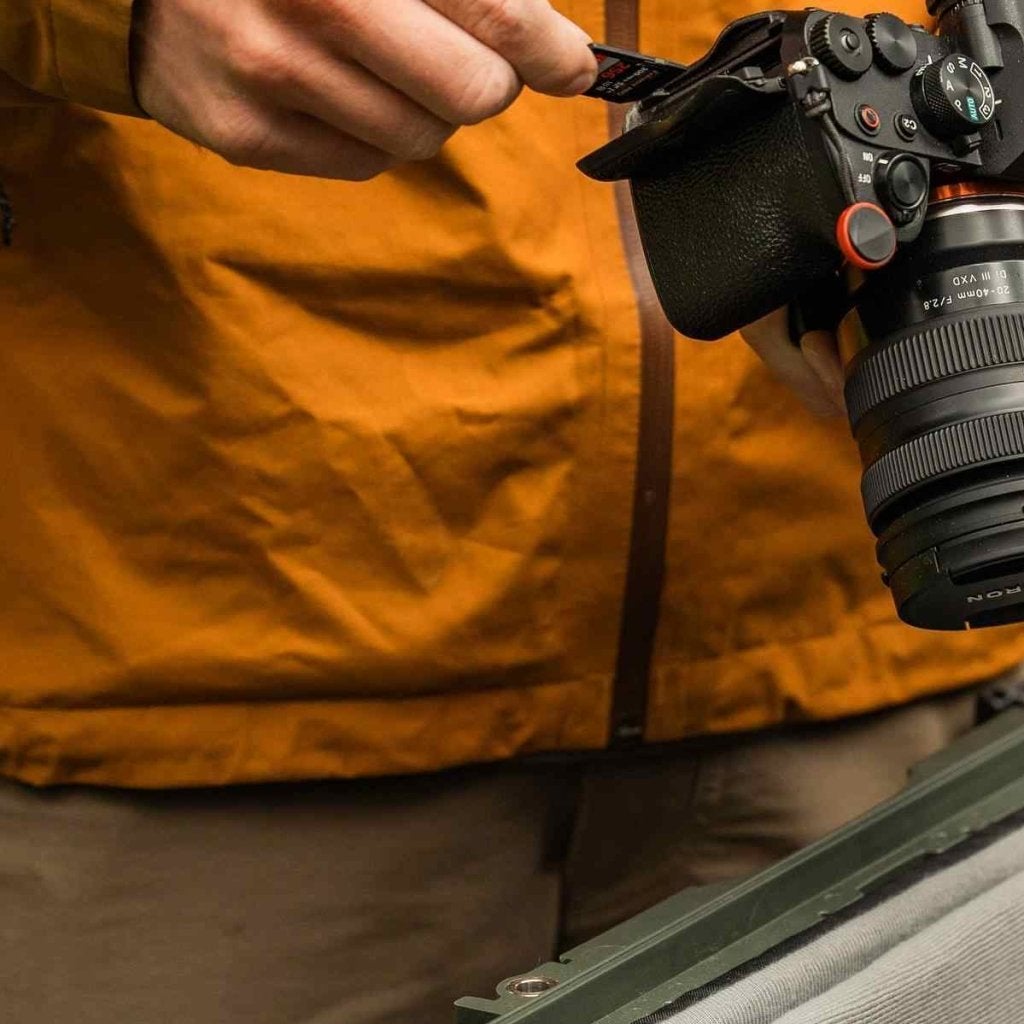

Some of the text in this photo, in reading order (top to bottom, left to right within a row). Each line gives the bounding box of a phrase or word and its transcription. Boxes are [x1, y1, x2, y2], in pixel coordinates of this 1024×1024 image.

[946, 62, 955, 74] S
[957, 57, 968, 69] M
[946, 80, 954, 91] A
[984, 86, 991, 98] 2
[954, 99, 962, 111] P
[966, 96, 979, 121] AUTO
[903, 118, 917, 130] C2
[862, 152, 874, 162] ON
[858, 173, 871, 184] OFF
[952, 276, 977, 286] VXD
[923, 285, 1010, 311] 20-40mm F/2.8
